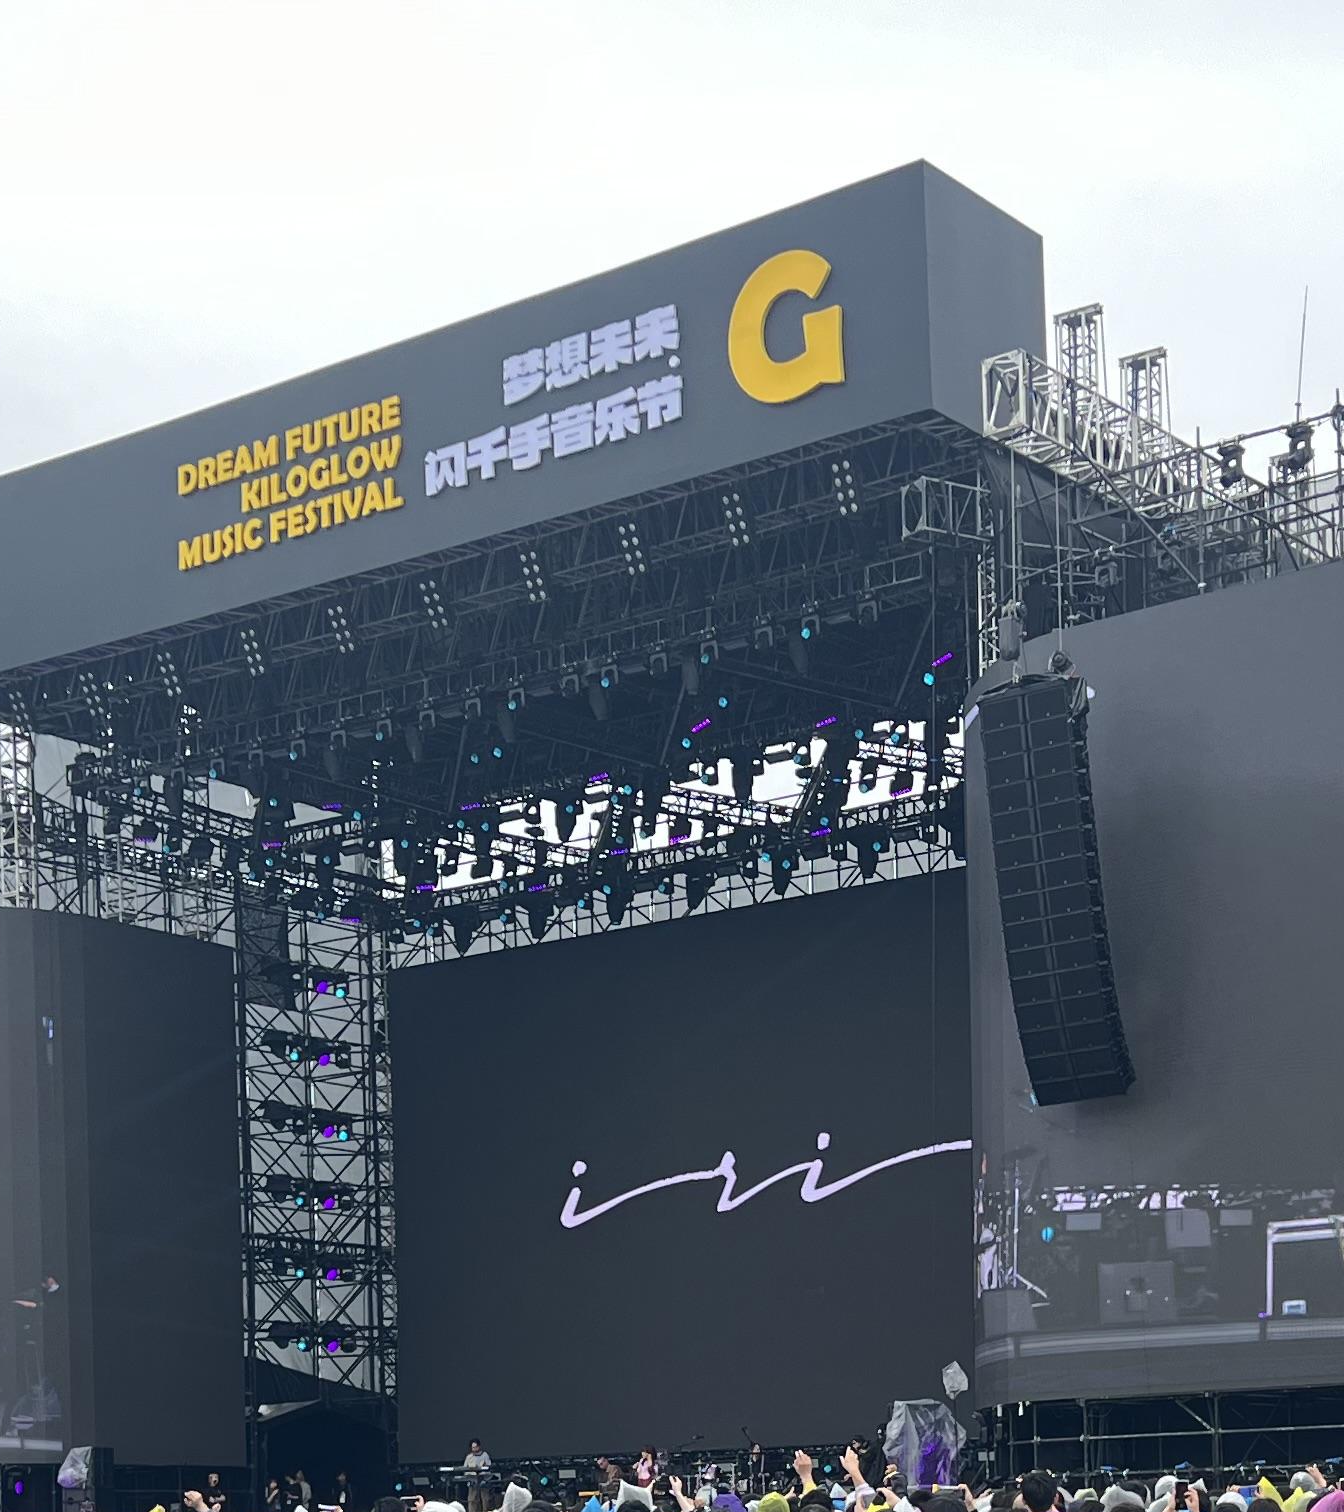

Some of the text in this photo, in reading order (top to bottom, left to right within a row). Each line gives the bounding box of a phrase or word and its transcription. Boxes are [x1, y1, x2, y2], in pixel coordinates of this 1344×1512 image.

[503, 303, 680, 406] 梦想未来
[728, 249, 844, 404] G
[178, 395, 401, 496] DREAM FUTURE
[241, 434, 402, 513] KILOGLOW
[425, 374, 684, 497] 闪千手音乐节
[178, 477, 405, 571] MUSIC FESTIVAL
[560, 1132, 973, 1229] iri
